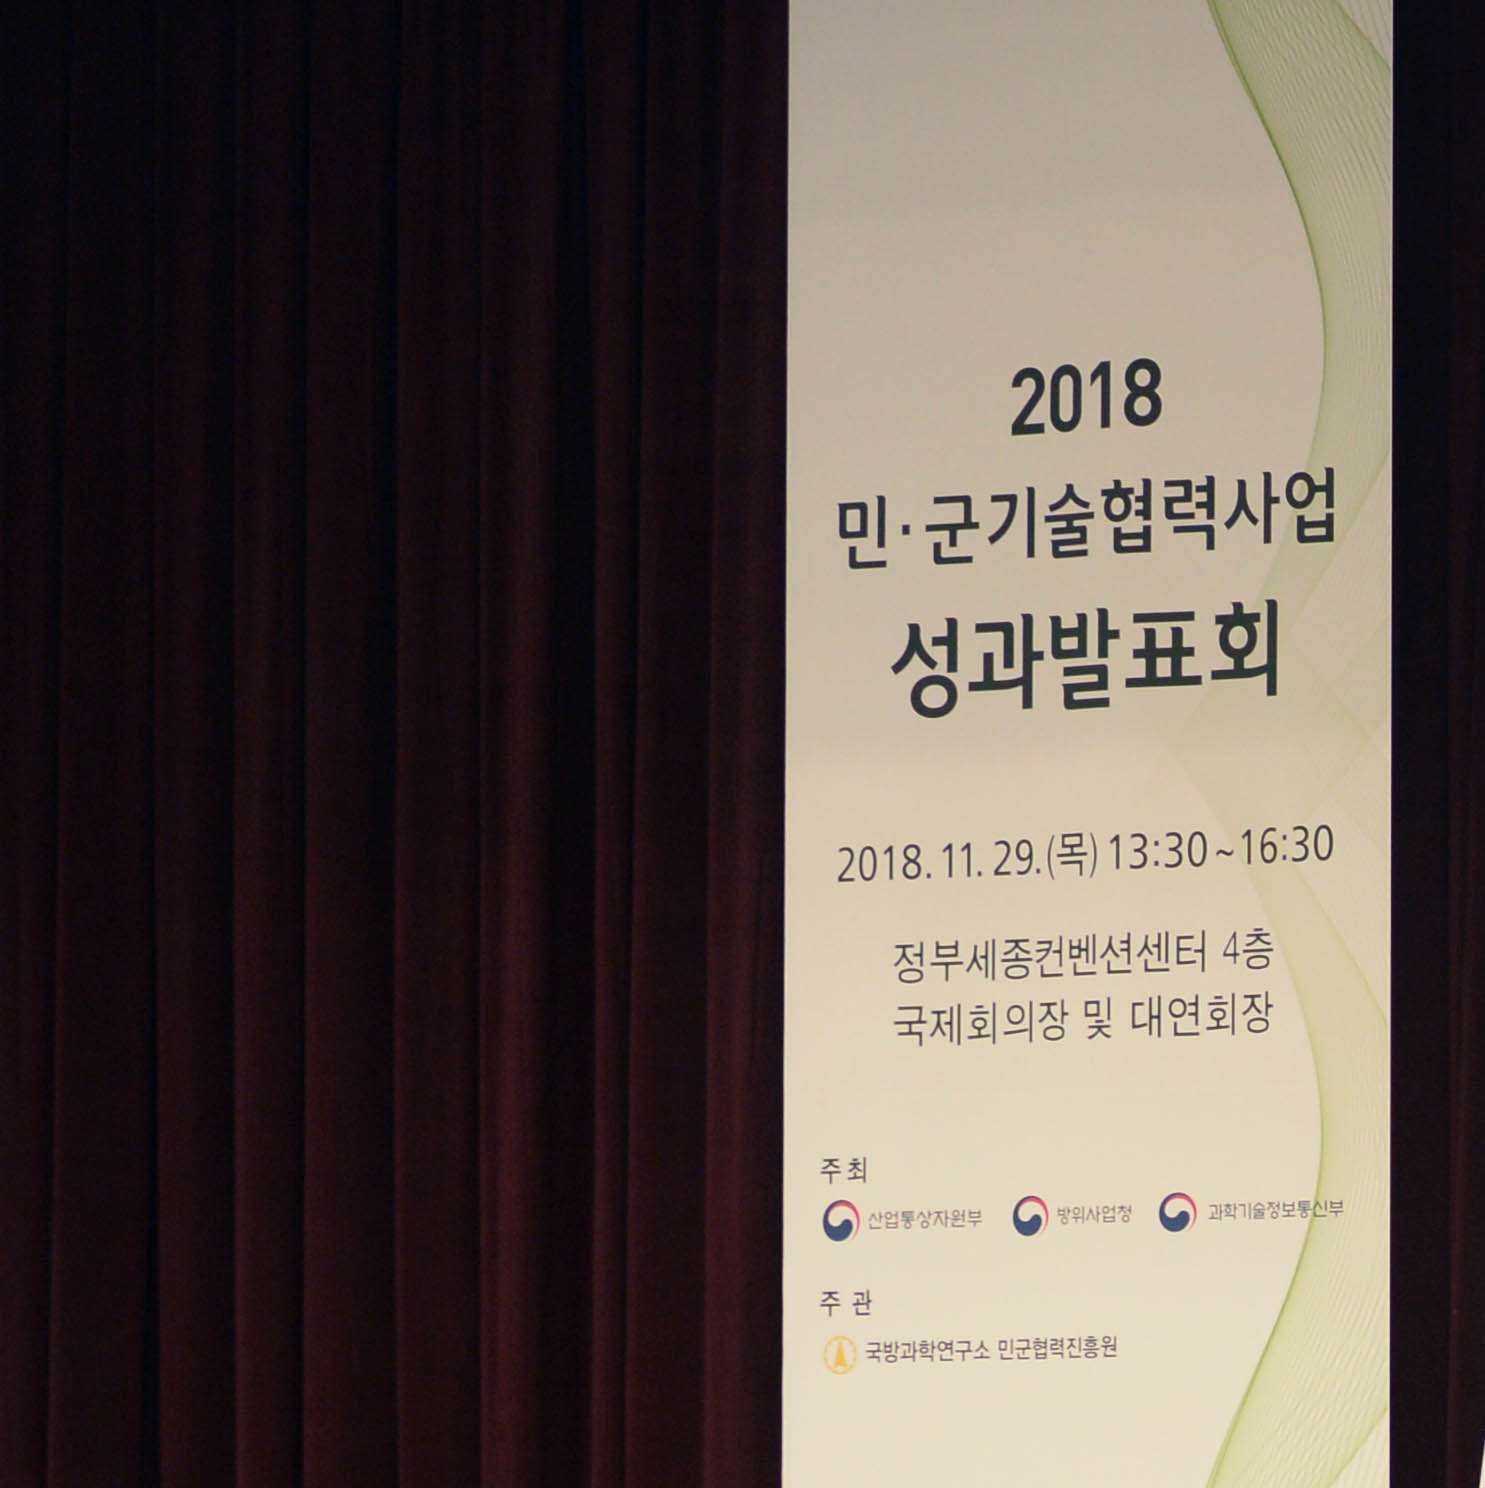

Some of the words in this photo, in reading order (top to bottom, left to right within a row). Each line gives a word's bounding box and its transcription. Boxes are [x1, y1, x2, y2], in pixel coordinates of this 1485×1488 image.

[1010, 357, 1163, 437] 2018
[837, 466, 1336, 571] 민·군기술협력사업
[890, 598, 1279, 719] 성과발표회
[837, 843, 932, 883] 2018.
[941, 841, 983, 879] 11.
[993, 831, 1098, 881] 29.(목)
[893, 928, 1206, 985] 정부세종컨벤션센터
[1222, 926, 1275, 971] 4층
[892, 998, 1070, 1048] 국제회의장
[1083, 995, 1113, 1041] 및
[1131, 990, 1275, 1039] 대연회장
[868, 1209, 983, 1230] 산업통상자원부
[1056, 1204, 1132, 1226] 방위사업청
[1207, 1200, 1345, 1222] 과학기술정보통신부
[865, 1339, 992, 1364] 국방과학연구소
[997, 1335, 1118, 1361] 민군협력진흥원
